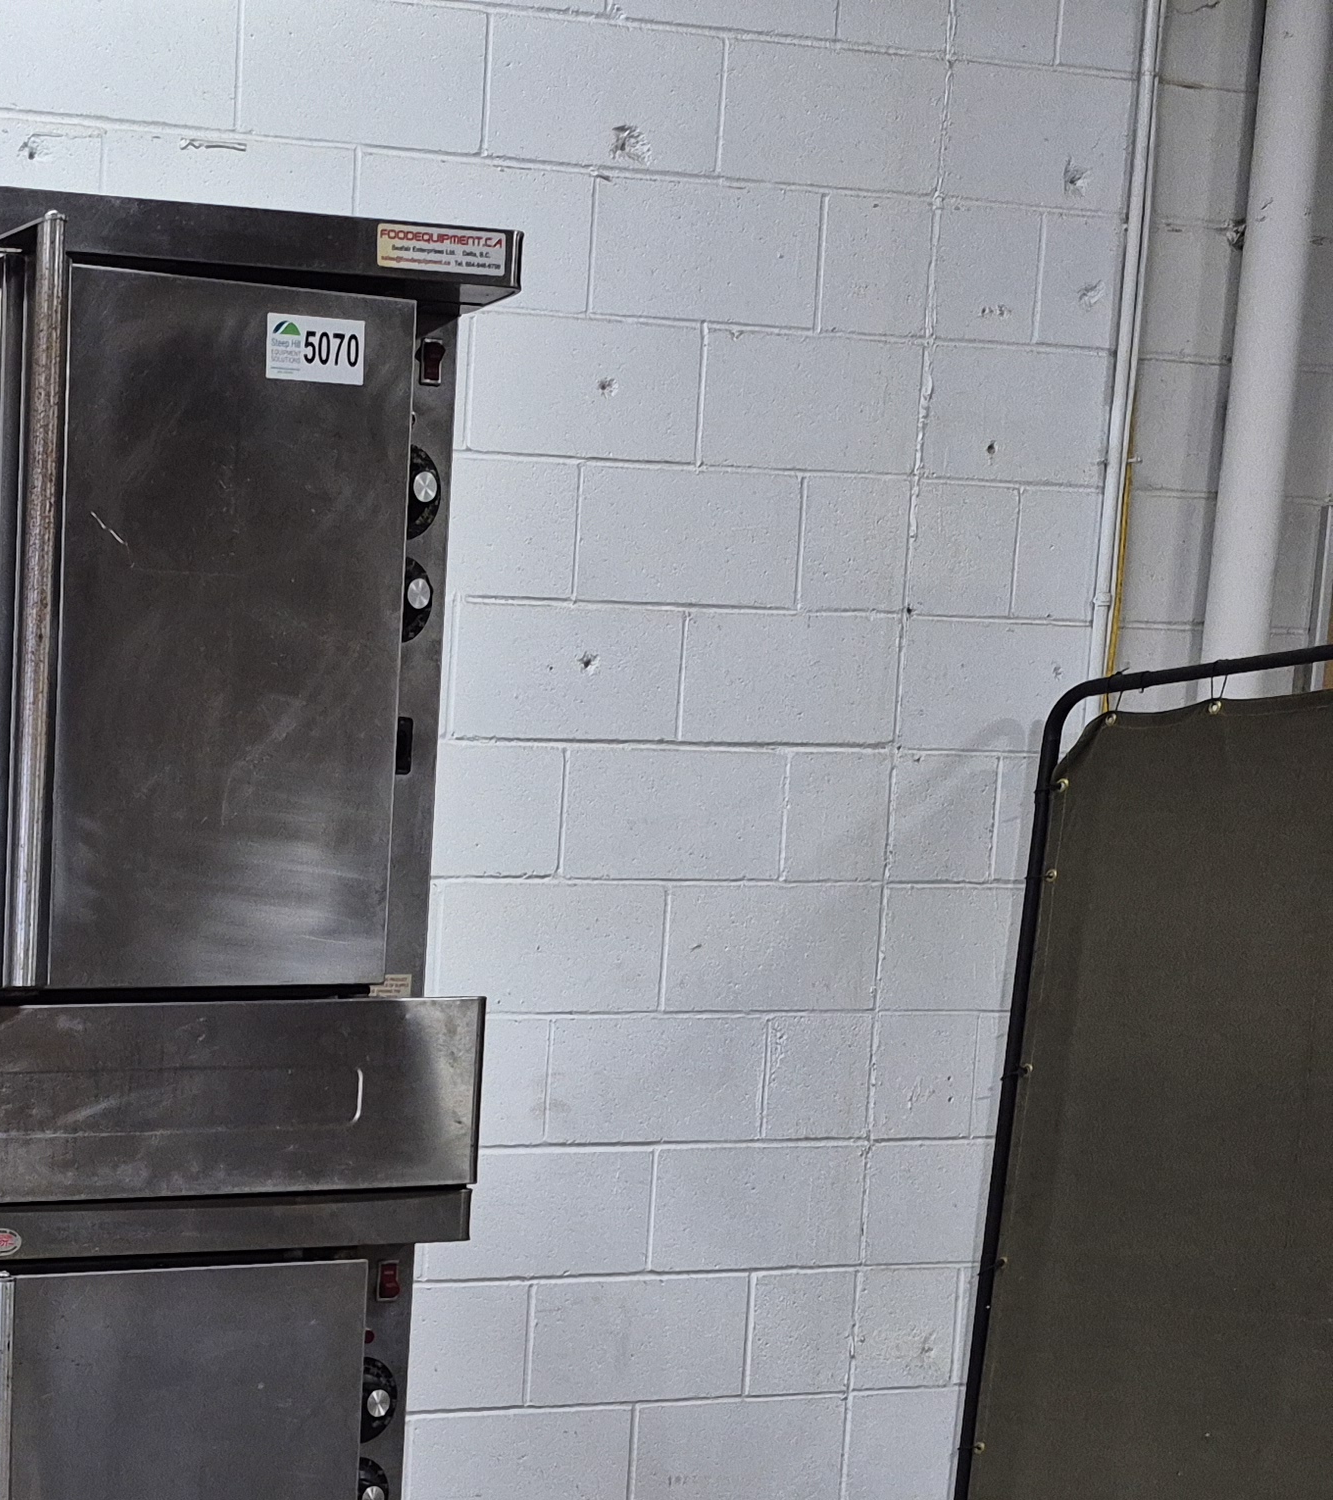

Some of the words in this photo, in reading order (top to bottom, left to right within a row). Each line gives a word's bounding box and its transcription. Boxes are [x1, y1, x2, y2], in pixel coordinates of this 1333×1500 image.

[379, 229, 503, 248] FOODEQUIPMENT.CA
[271, 338, 290, 349] Steep
[291, 339, 301, 348] Hill
[303, 330, 360, 367] 5070
[271, 349, 301, 357] EQUIPMENT
[271, 356, 301, 364] SOLUTIONS
